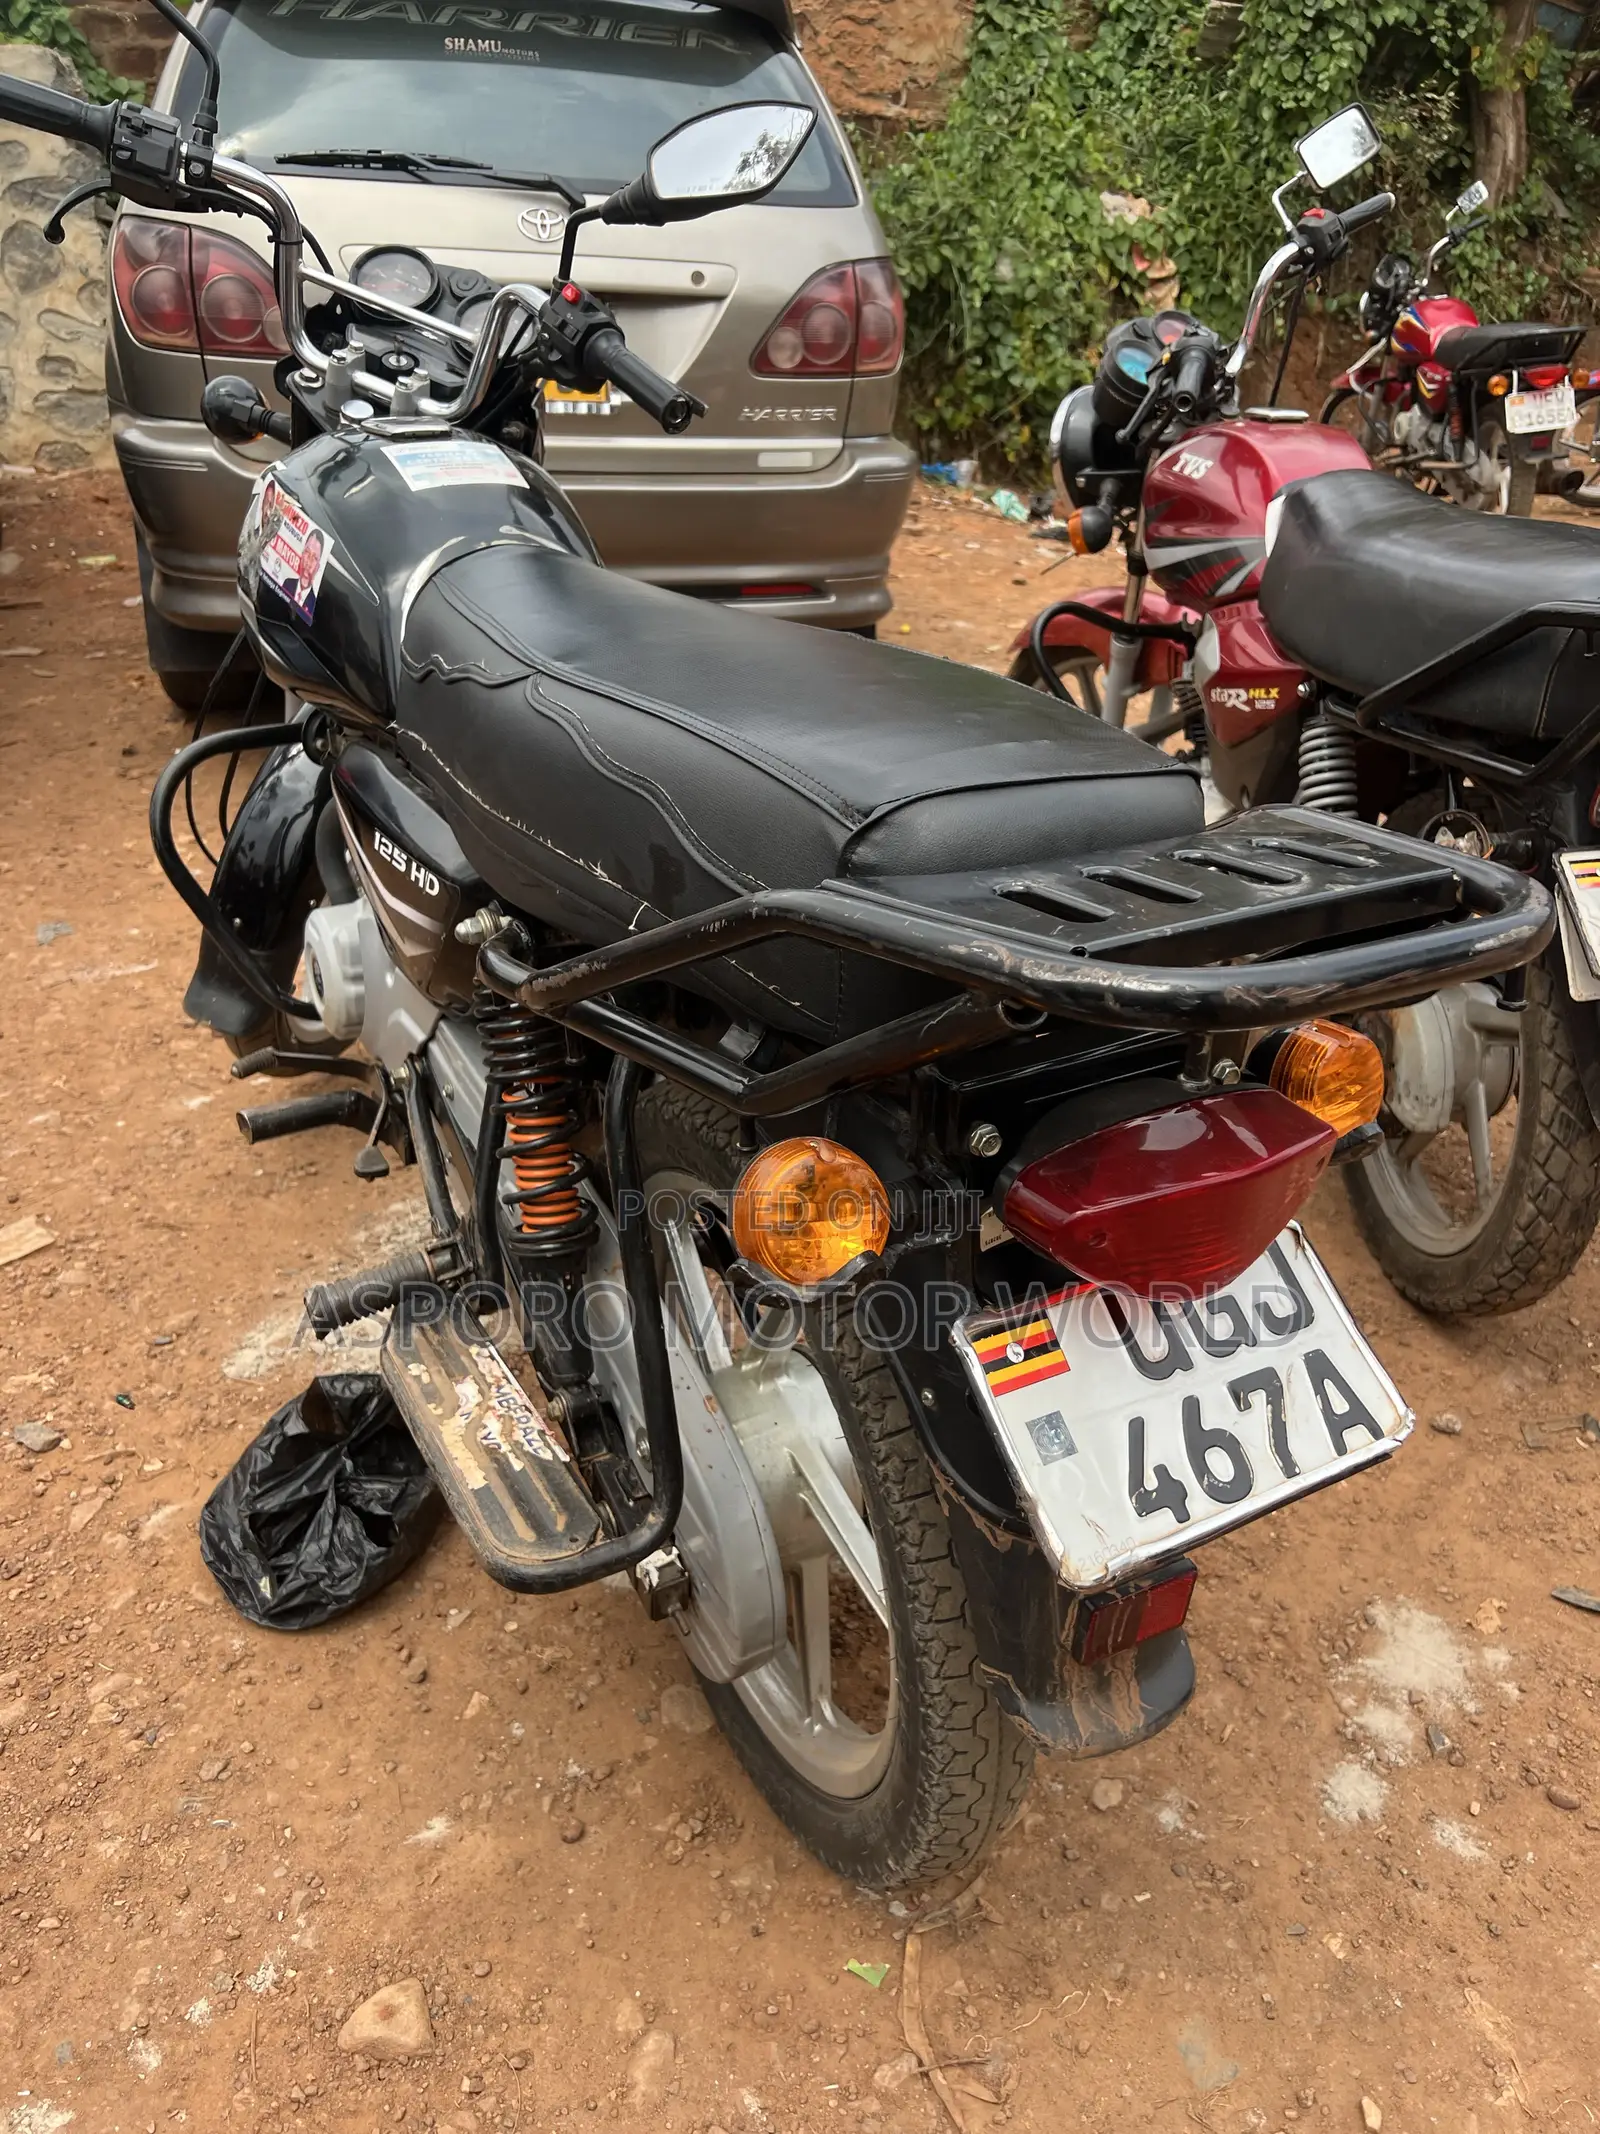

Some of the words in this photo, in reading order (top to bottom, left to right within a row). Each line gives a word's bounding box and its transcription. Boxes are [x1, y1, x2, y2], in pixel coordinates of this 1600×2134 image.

[266, 0, 752, 55] HARRIER
[444, 37, 502, 53] SHAMU
[738, 405, 837, 421] HARRIER
[1172, 452, 1214, 479] TVS
[278, 544, 301, 574] MAYOR
[1248, 687, 1280, 699] HLX
[373, 830, 408, 873] 125
[410, 860, 440, 897] HD
[1127, 1348, 1385, 1524] 467A
